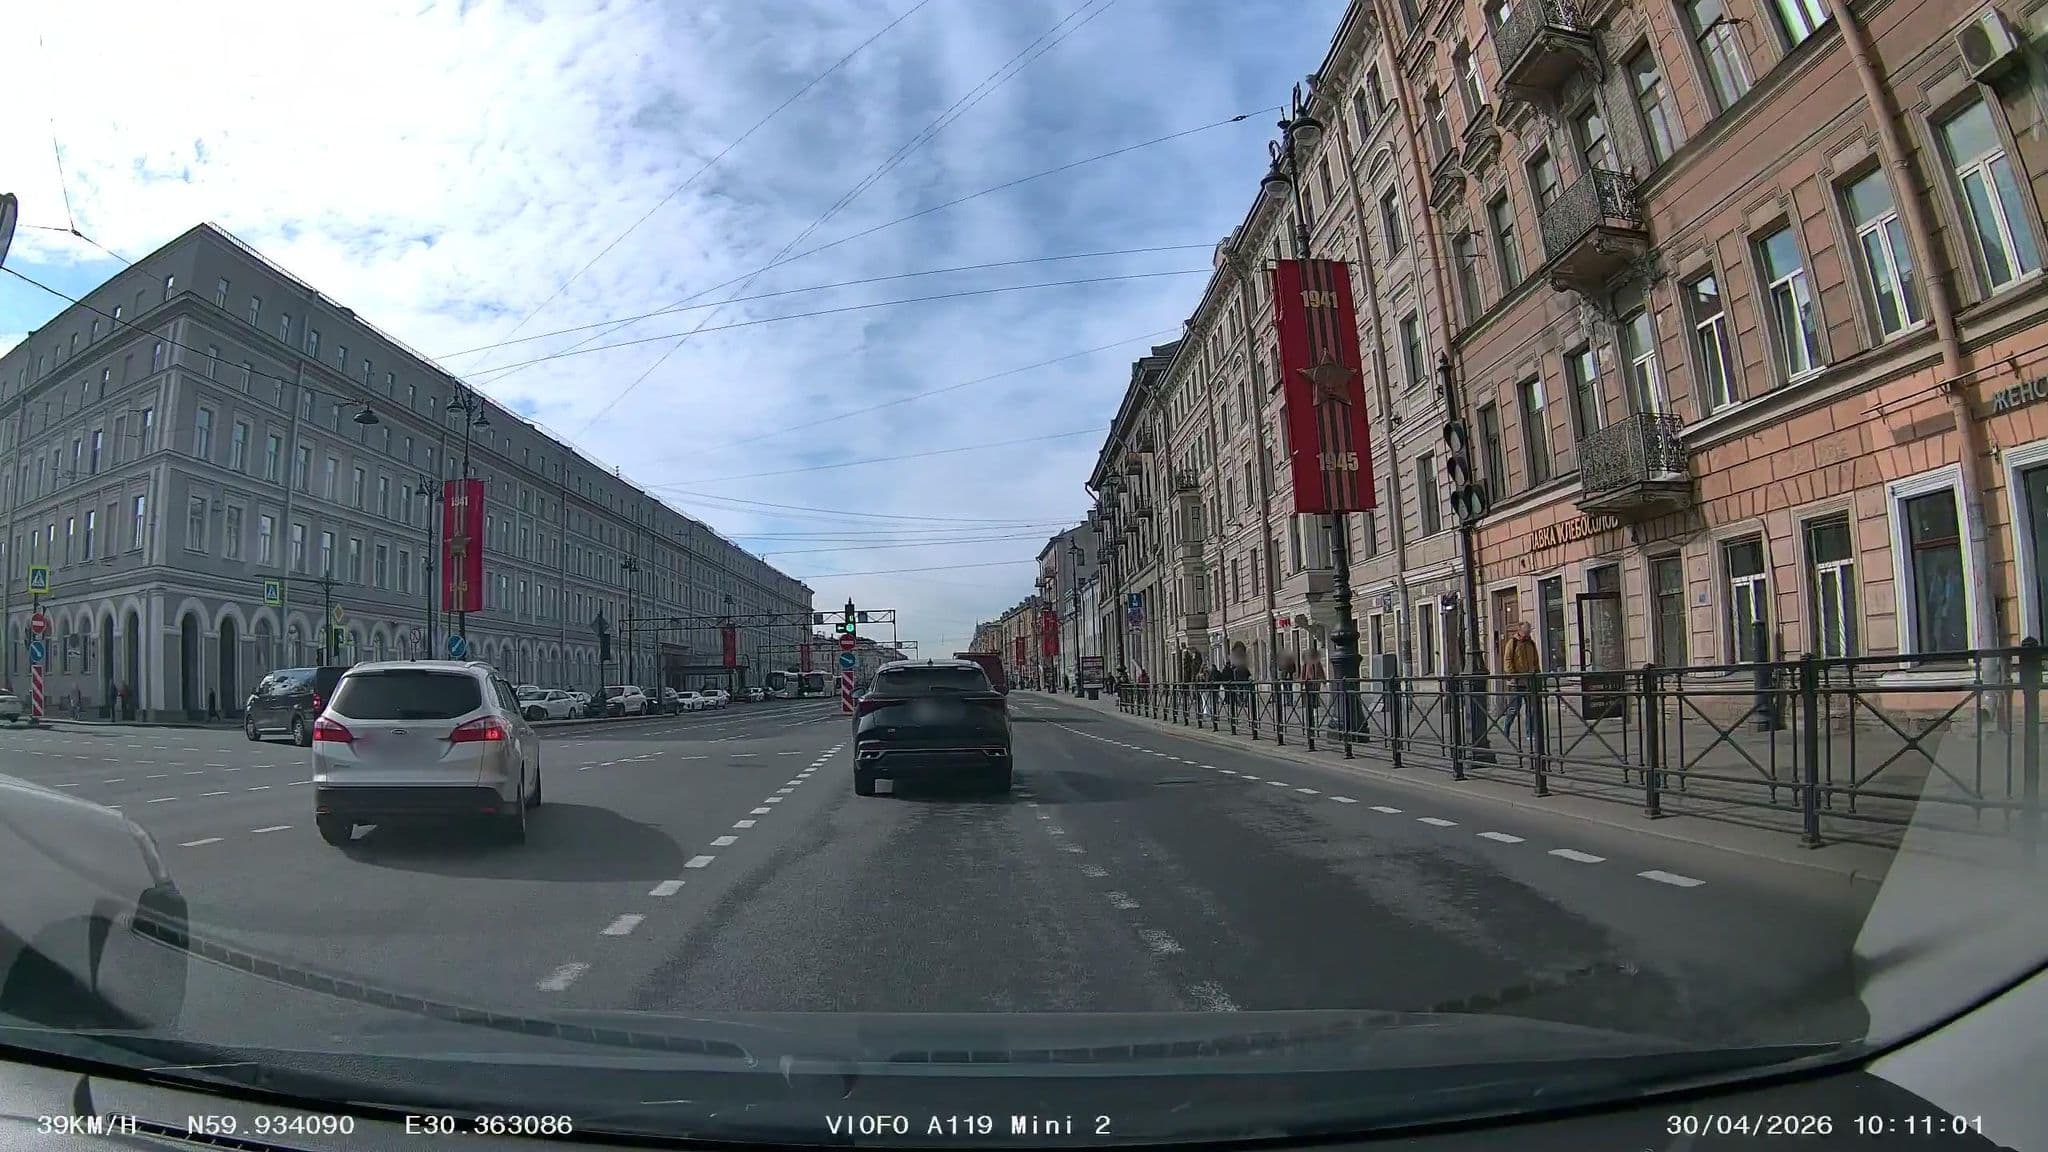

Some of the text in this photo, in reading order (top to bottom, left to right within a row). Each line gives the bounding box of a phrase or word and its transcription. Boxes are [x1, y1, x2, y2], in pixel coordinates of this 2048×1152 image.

[1300, 290, 1338, 309] 1941
[1316, 452, 1359, 471] 1945
[451, 496, 468, 506] 1941
[1530, 525, 1556, 551] ЛАВКА
